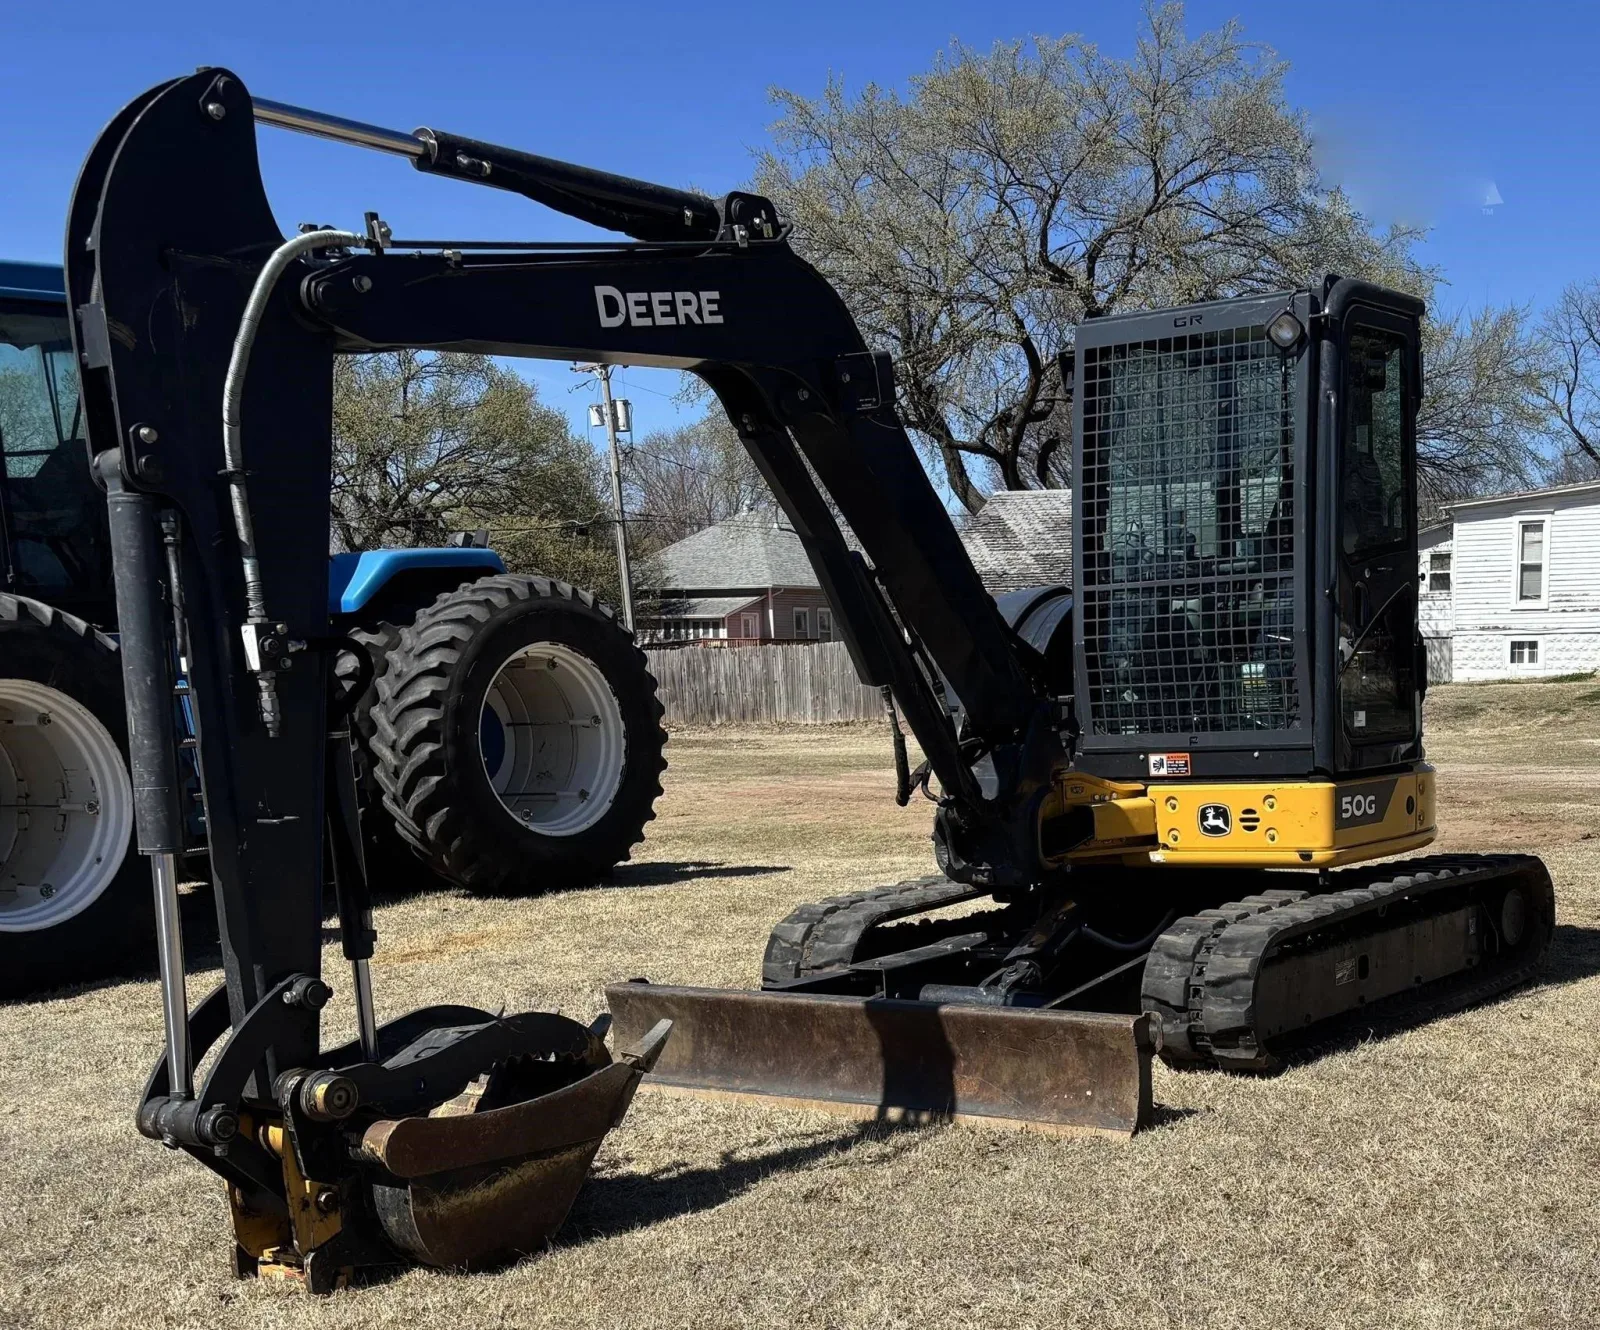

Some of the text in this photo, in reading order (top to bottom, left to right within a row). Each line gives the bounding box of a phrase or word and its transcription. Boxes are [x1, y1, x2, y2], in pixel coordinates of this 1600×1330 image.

[594, 285, 724, 328] DEERE
[1173, 314, 1203, 328] GR
[1342, 794, 1376, 819] 50G
